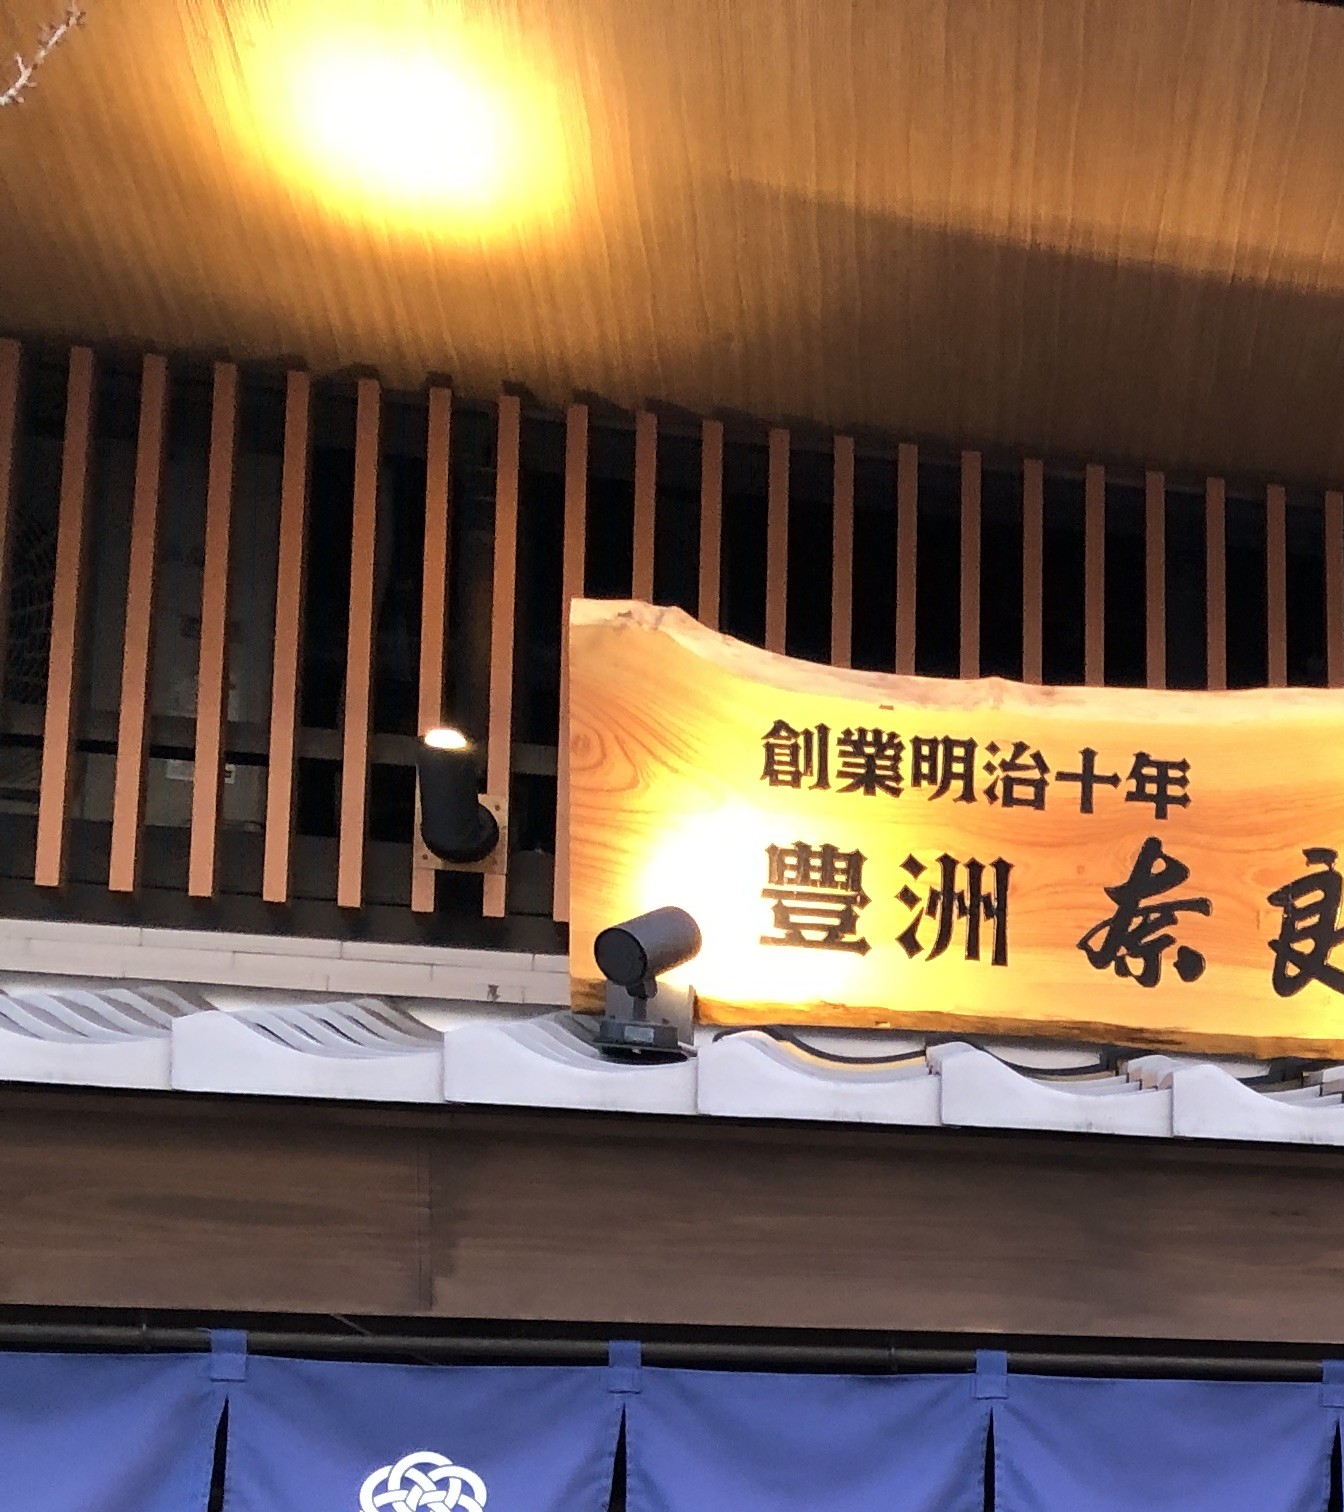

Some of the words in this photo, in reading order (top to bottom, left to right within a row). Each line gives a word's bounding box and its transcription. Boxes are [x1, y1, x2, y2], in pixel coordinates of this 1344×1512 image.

[760, 718, 1192, 820] 創業明治十年
[760, 839, 1014, 967] 豊洲
